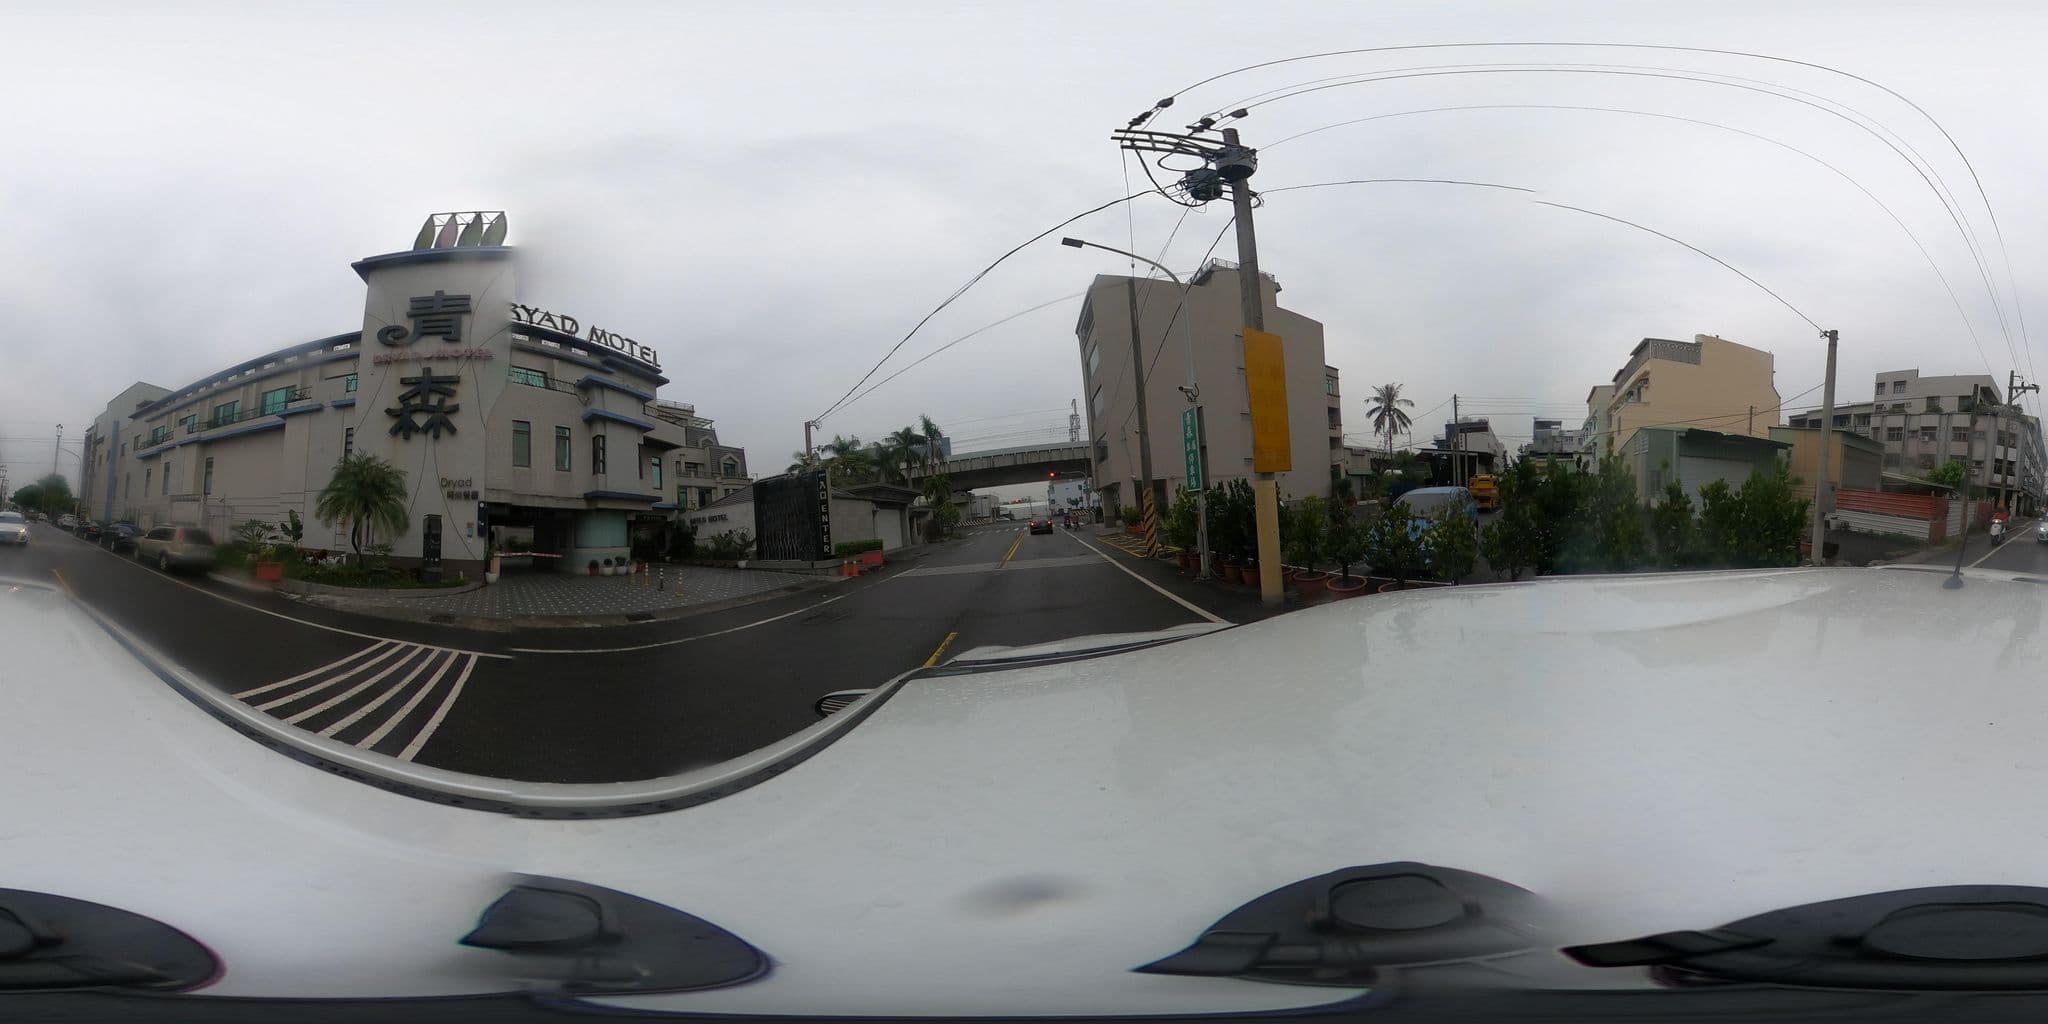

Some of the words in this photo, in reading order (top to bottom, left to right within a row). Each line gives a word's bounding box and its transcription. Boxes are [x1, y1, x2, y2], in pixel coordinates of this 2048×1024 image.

[589, 325, 661, 368] MOTEL
[441, 476, 472, 489] Dryad
[821, 504, 830, 553] ENTER
